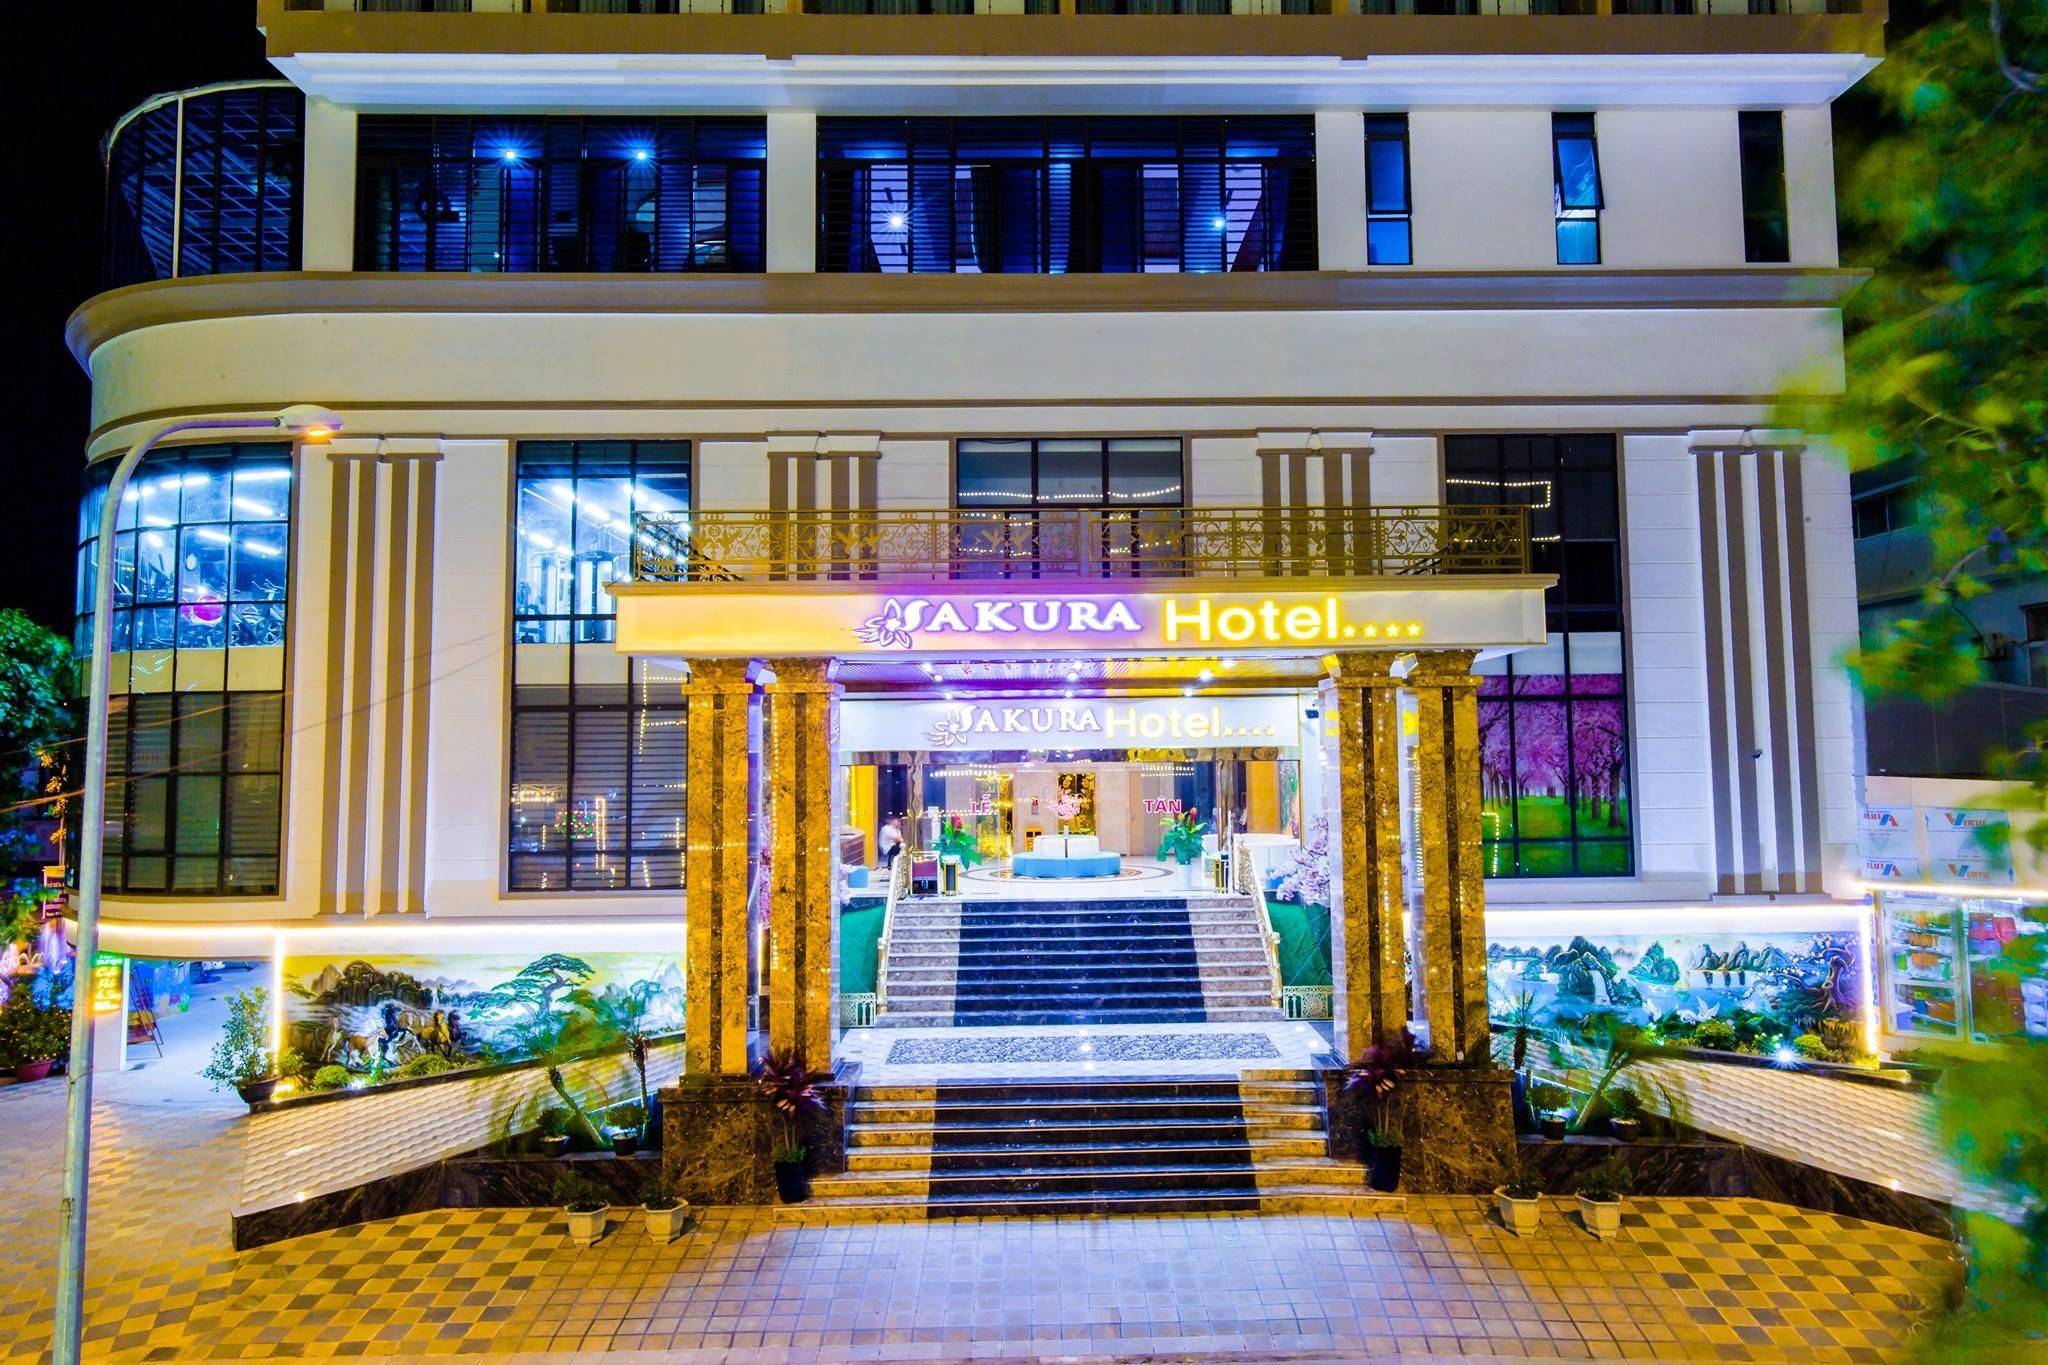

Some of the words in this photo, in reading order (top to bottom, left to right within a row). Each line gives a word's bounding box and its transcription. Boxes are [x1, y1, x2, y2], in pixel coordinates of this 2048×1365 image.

[901, 600, 1143, 632] SAKURA
[1165, 597, 1339, 642] Hotel
[958, 704, 1102, 733] SAKURA
[1105, 705, 1221, 738] Hotel
[1143, 796, 1181, 814] TÂN
